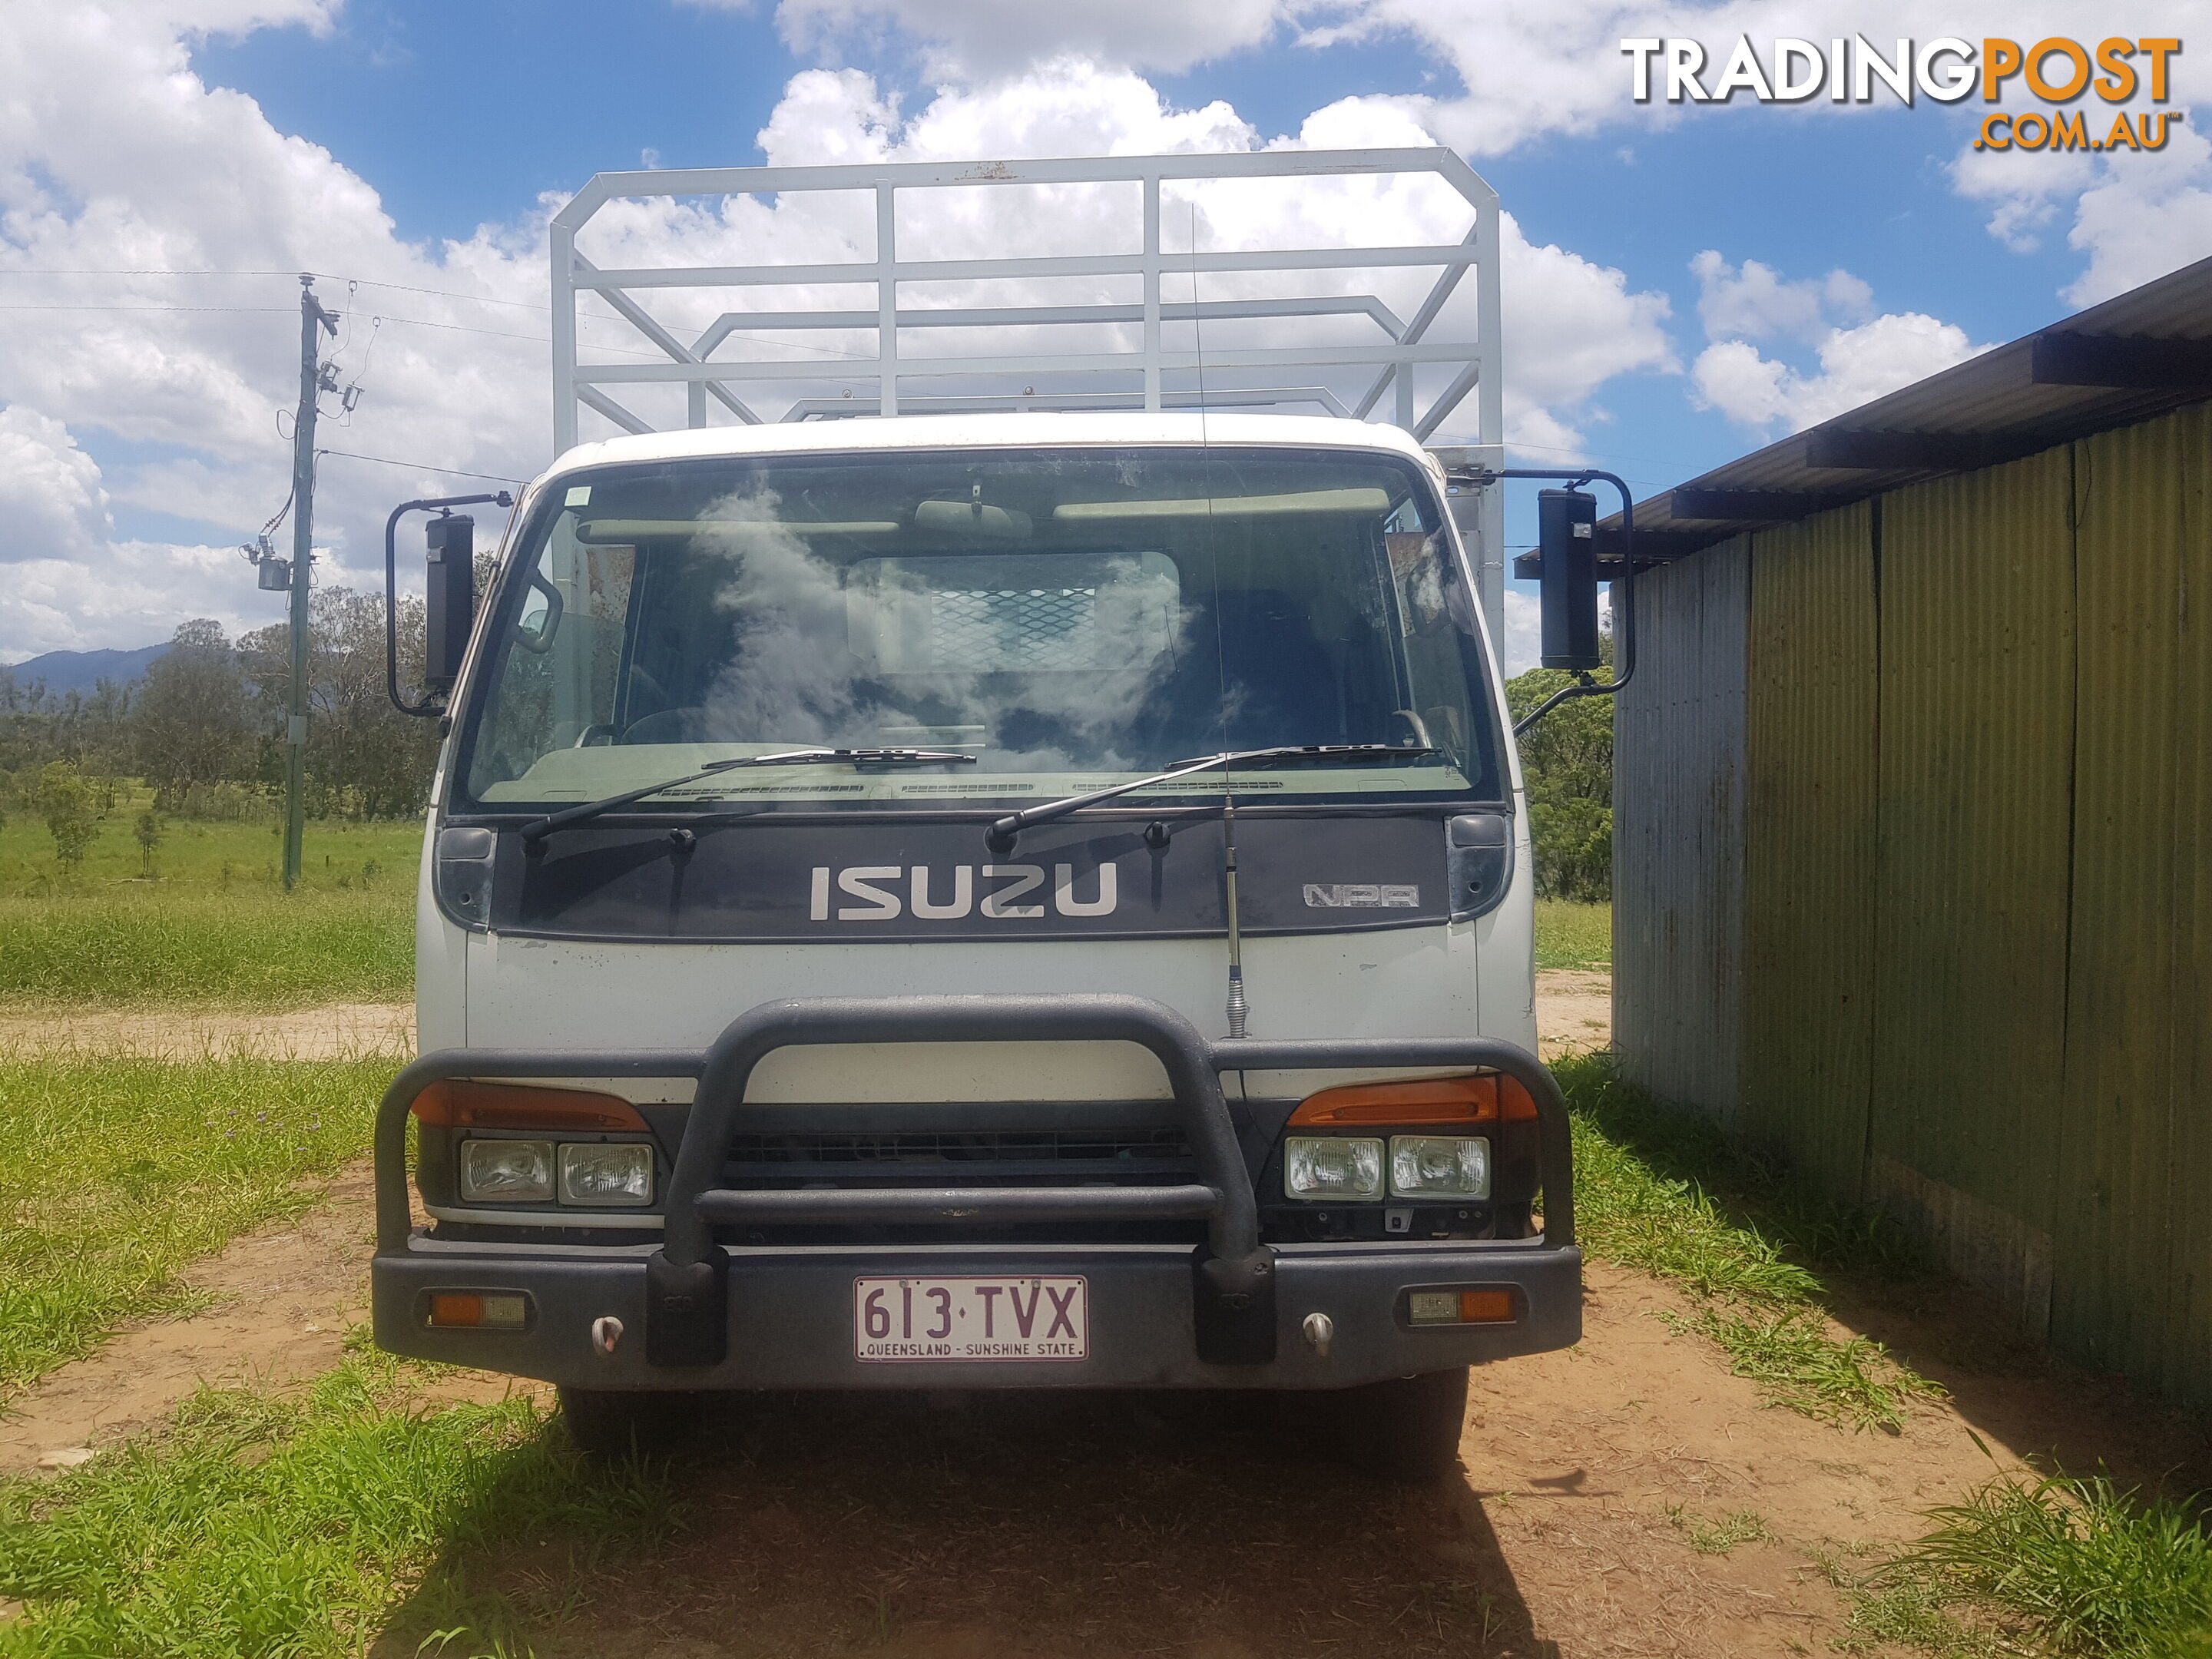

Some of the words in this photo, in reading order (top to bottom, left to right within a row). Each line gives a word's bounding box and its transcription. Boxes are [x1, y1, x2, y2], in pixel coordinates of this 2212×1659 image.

[810, 863, 1118, 921] ISUZU
[1303, 885, 1419, 908] NPR
[867, 1344, 952, 1356] QUEENSLAND
[965, 1343, 1030, 1356] SUNSHINE
[1037, 1343, 1076, 1356] STATE
